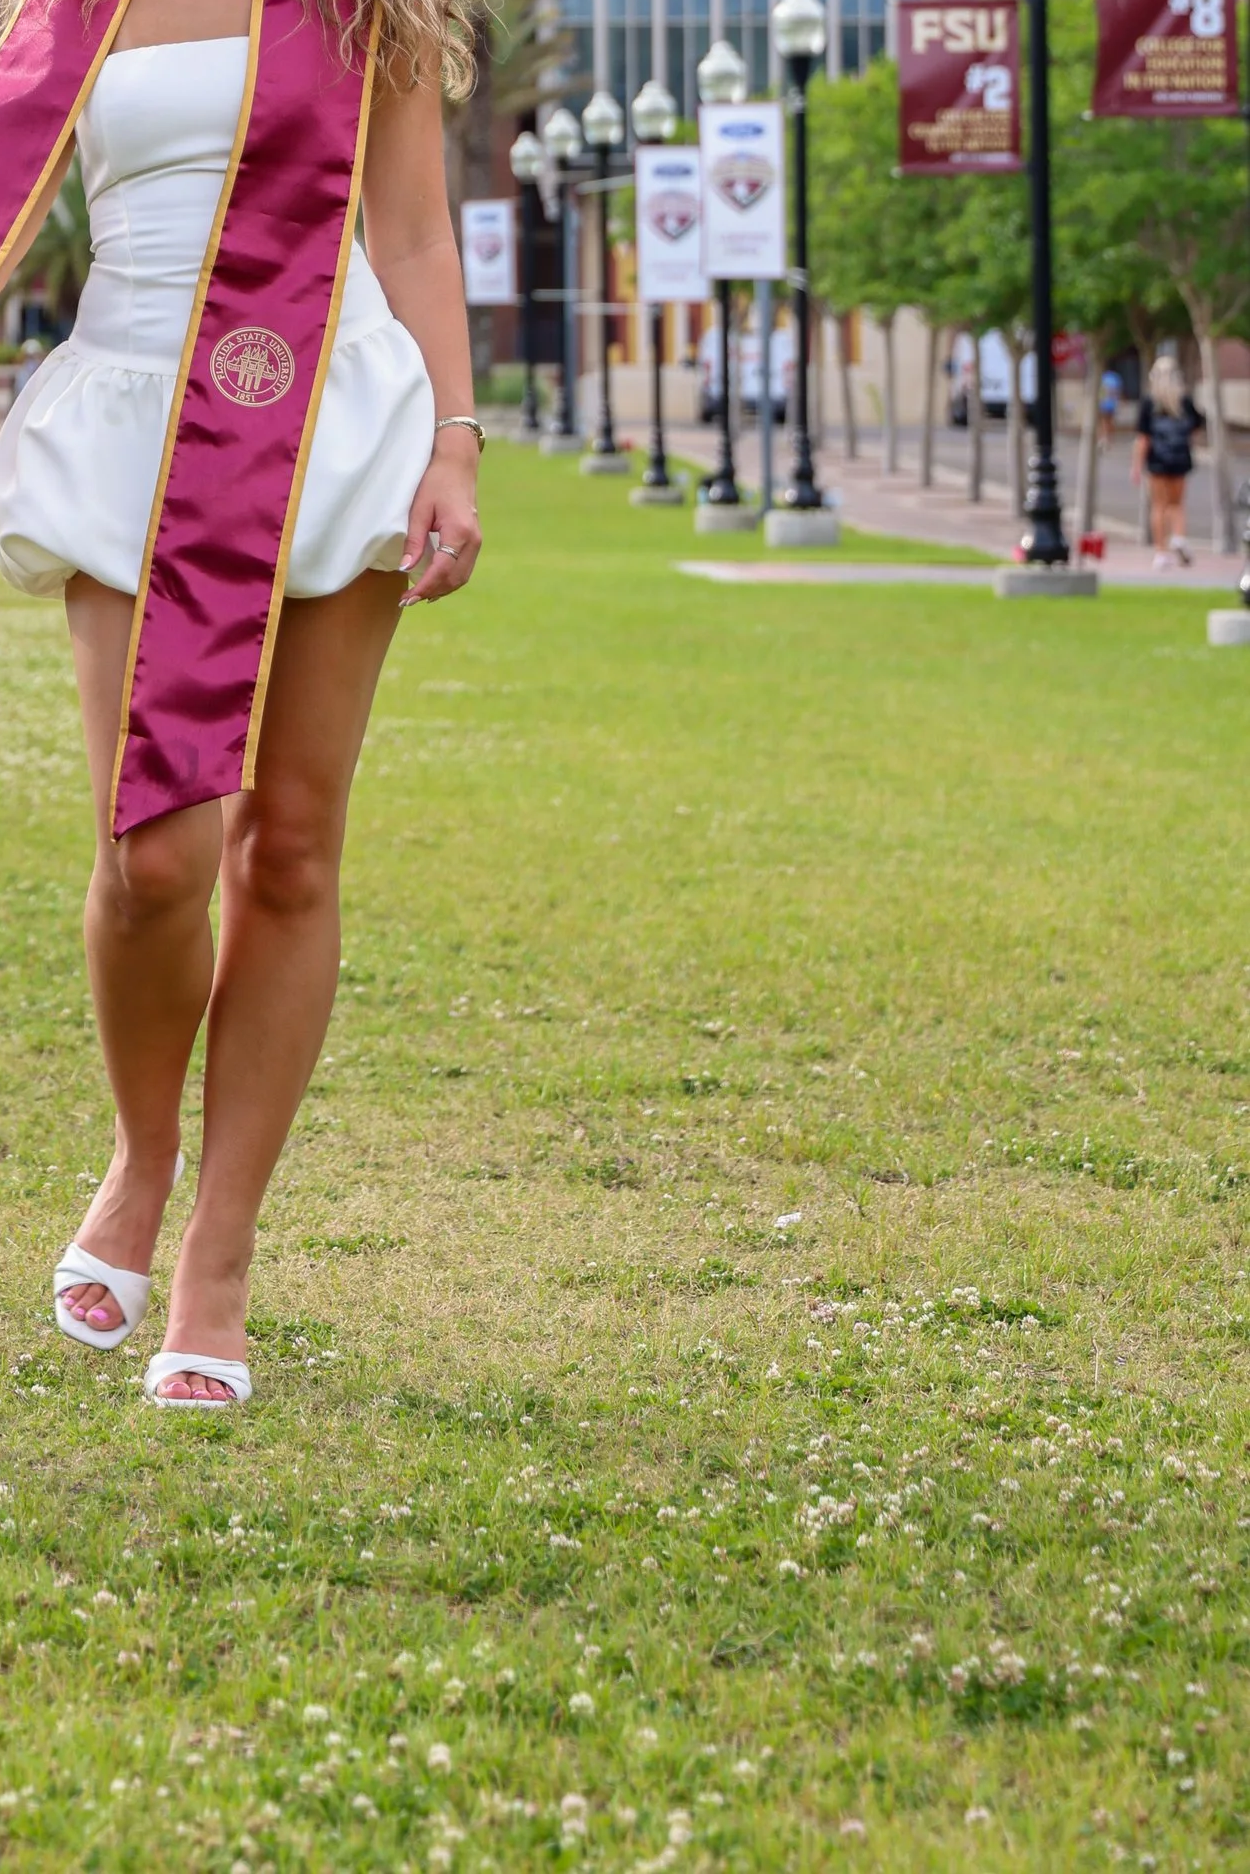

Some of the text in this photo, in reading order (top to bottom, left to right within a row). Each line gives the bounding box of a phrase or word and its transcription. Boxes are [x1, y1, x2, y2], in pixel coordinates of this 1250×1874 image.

[911, 7, 1009, 54] FSU
[964, 62, 1012, 111] #2
[215, 340, 236, 380] FLORIDA
[236, 332, 268, 343] STATE
[269, 338, 290, 395] UNIVERSITY
[234, 391, 256, 403] 1851
